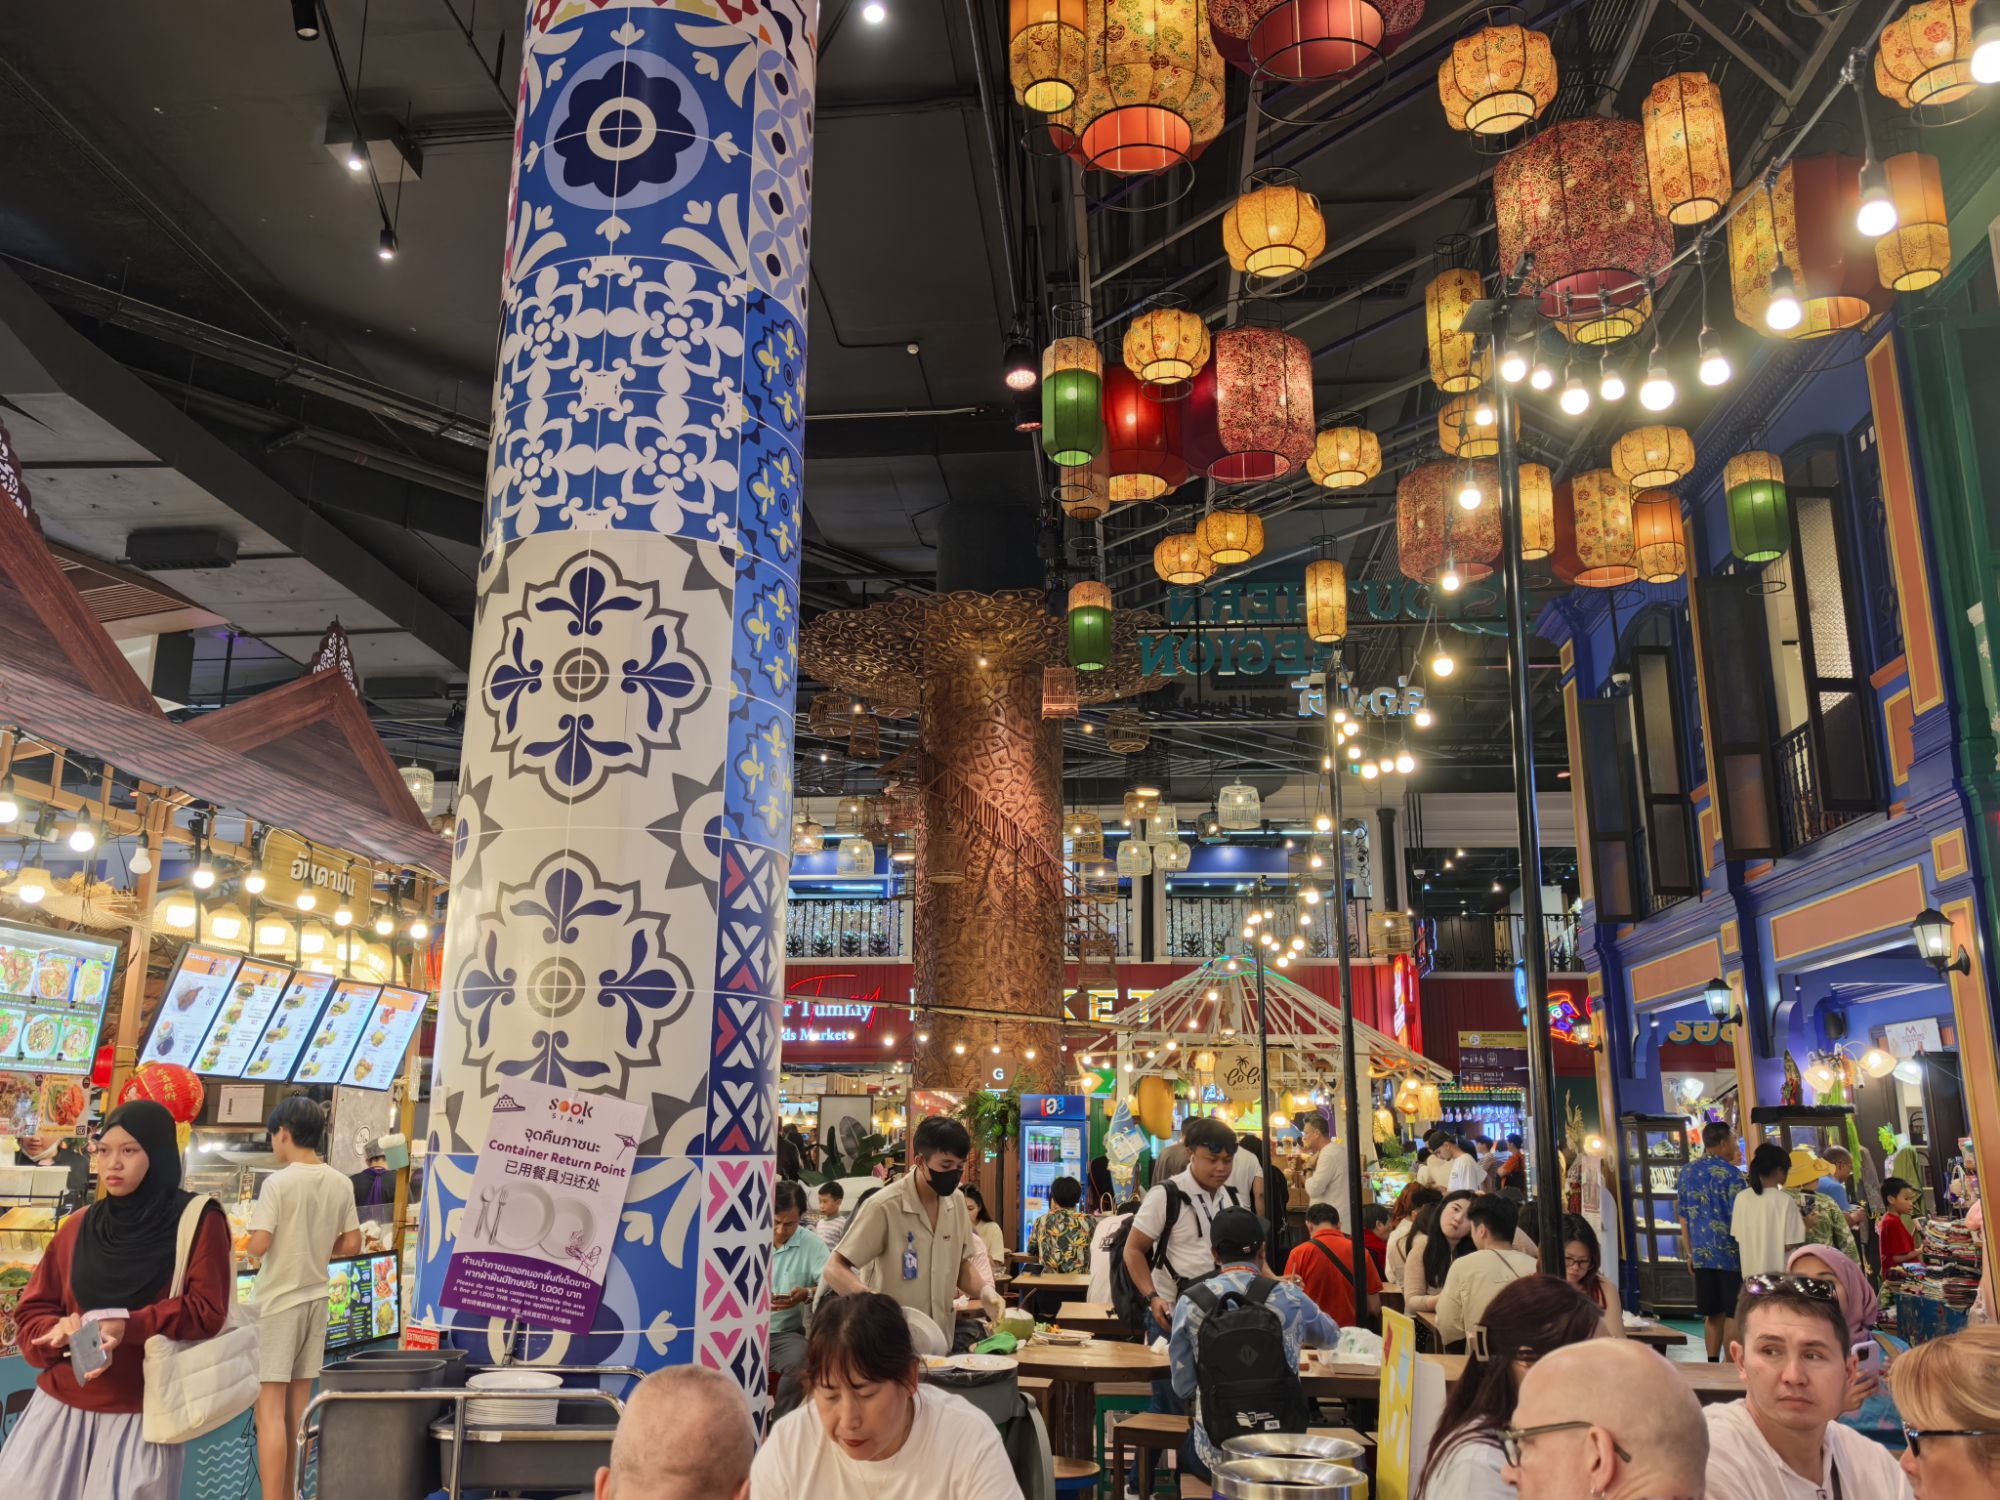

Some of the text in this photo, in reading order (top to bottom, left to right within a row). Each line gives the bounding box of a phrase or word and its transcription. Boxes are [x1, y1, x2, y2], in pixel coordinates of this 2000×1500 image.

[992, 1068, 1005, 1080] G
[552, 1113, 584, 1125] SIAM
[525, 1128, 601, 1153] จุดคืนภาชนะ
[489, 1140, 627, 1177] Container Return Point
[505, 1160, 600, 1192] 已用餐具归还处
[456, 1279, 474, 1288] Please
[496, 1286, 508, 1294] take
[509, 1290, 538, 1300] containers
[540, 1294, 561, 1304] outside
[541, 1284, 564, 1296] 1,000
[566, 1292, 582, 1300] บาท
[511, 1297, 522, 1305] may
[533, 1301, 554, 1311] applied
